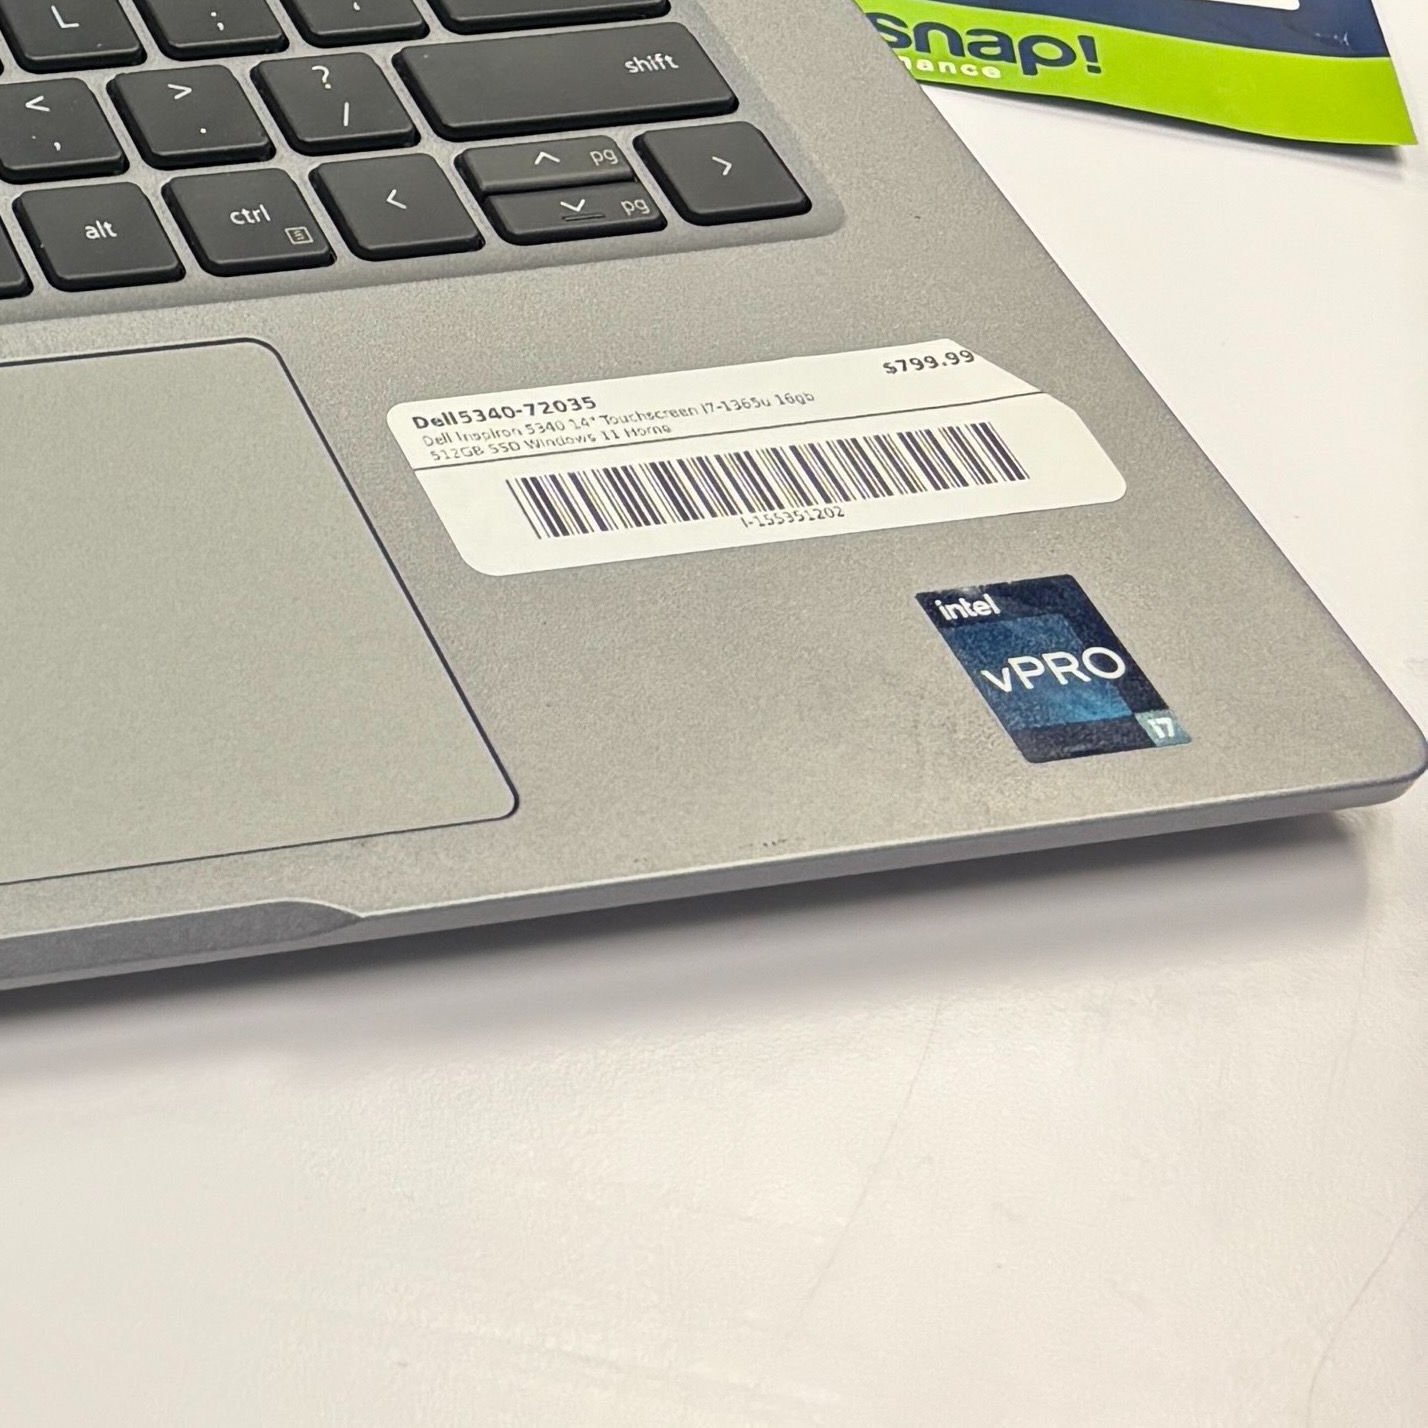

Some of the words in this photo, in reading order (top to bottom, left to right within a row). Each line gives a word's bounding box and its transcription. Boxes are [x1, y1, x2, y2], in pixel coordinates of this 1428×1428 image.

[865, 11, 1102, 76] snap!
[625, 54, 678, 72] shift
[899, 55, 1002, 79] nance
[590, 150, 618, 165] pg
[230, 205, 270, 224] ctrl
[621, 200, 650, 215] pg
[85, 221, 117, 239] alt
[412, 396, 598, 431] Dell5340-72035
[883, 347, 976, 377] $799.99
[423, 431, 453, 448] Dell
[456, 427, 522, 446] Inspiron
[525, 419, 566, 436] 5340
[600, 405, 699, 426] Touchscreen
[774, 390, 816, 408] 16gb
[430, 446, 485, 462] 512GB
[487, 440, 522, 455] SSD
[525, 433, 597, 452] Windows
[602, 431, 620, 442] 11
[623, 424, 673, 439] Home
[935, 594, 1000, 620] intel
[981, 647, 1125, 692] vPRO
[1147, 718, 1174, 738] i7
